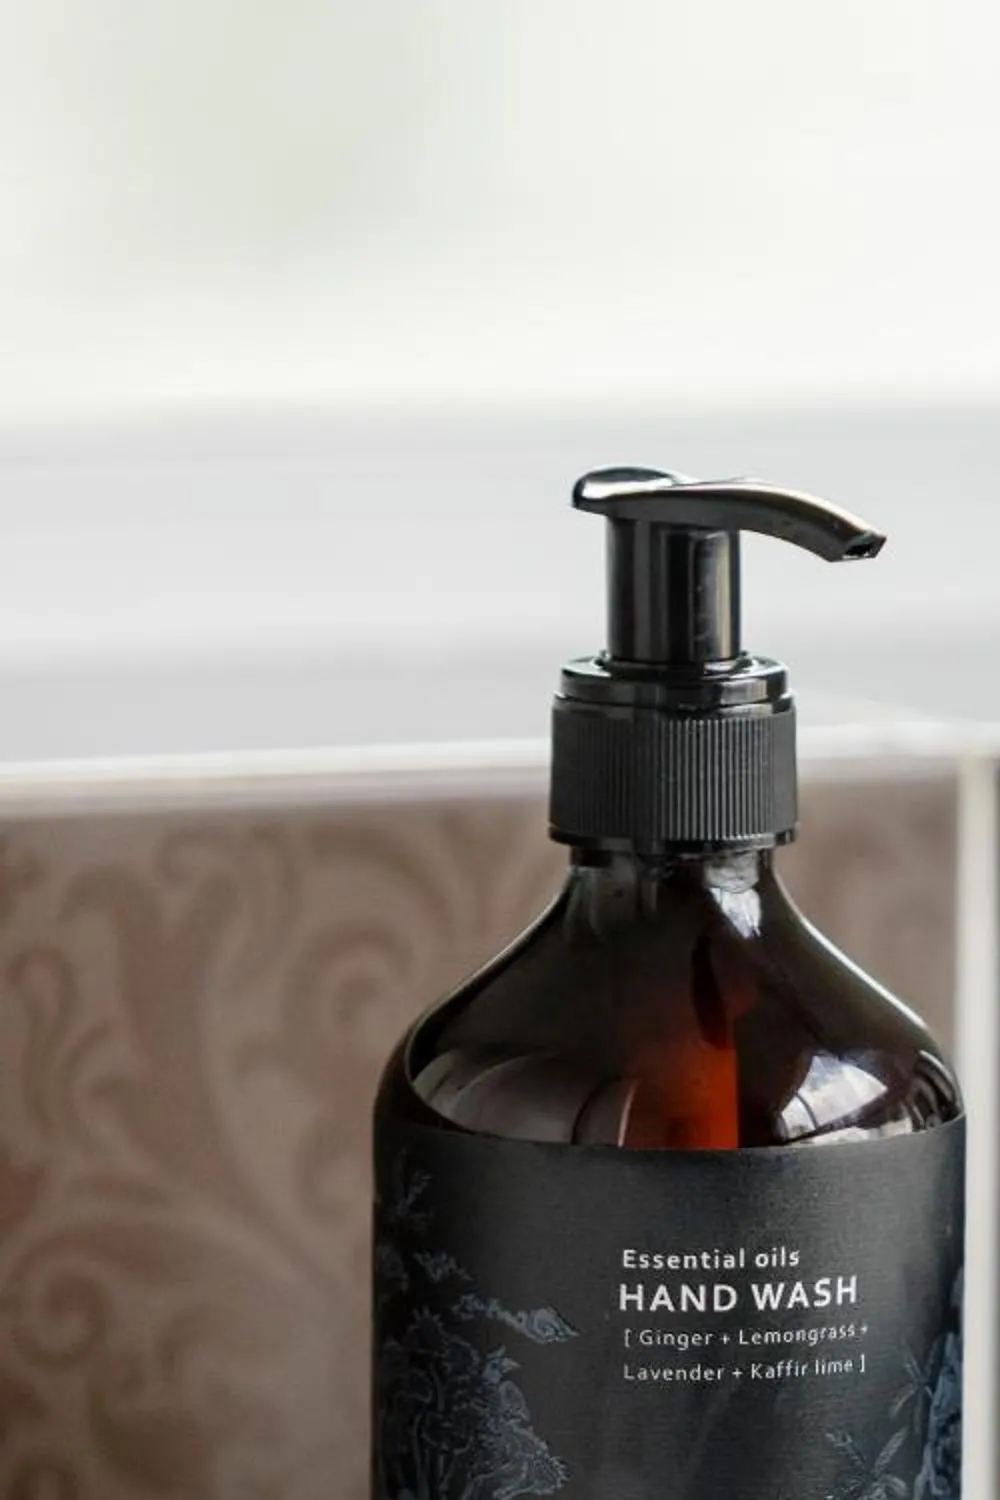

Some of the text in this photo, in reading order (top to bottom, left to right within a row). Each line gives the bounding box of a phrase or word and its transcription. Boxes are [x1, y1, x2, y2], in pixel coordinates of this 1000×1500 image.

[622, 1245, 800, 1270] Essential oils
[618, 1274, 858, 1312] HAND WASH
[624, 1328, 631, 1348] [
[639, 1328, 713, 1351] Ginger
[720, 1333, 731, 1343] +
[738, 1324, 856, 1347] Lemongrass
[623, 1353, 866, 1382] Lavender + Kaffir lime ]
